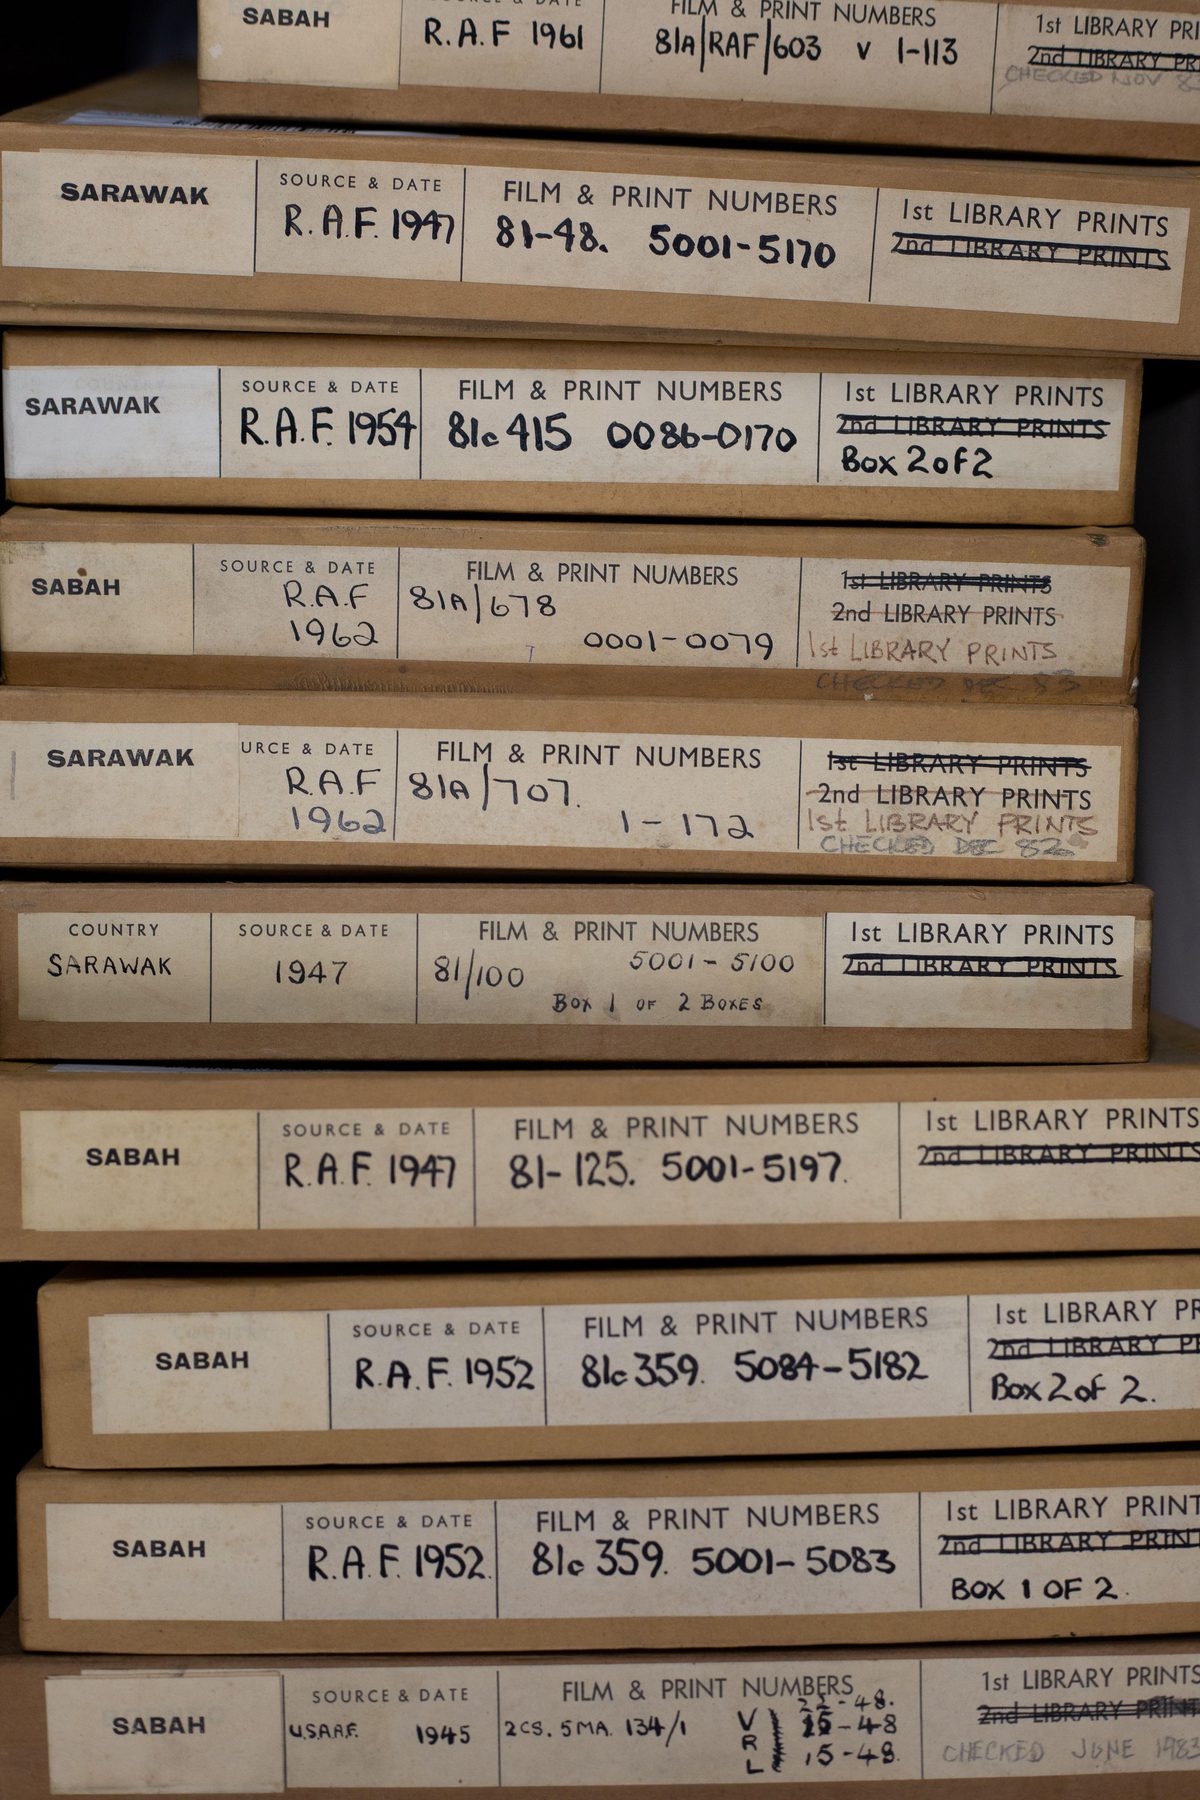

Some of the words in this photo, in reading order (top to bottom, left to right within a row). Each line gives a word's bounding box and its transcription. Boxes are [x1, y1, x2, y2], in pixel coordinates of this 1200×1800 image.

[243, 7, 329, 28] SABAH
[672, 0, 717, 20] FILM
[731, 0, 746, 18] &
[760, 0, 820, 22] PRINT
[834, 3, 936, 27] NUMBERS
[425, 17, 510, 48] R.A.F
[532, 21, 583, 50] 1961
[1037, 14, 1061, 34] 1st
[1074, 16, 1158, 38] LIBRARY
[898, 37, 958, 66] 1-113
[61, 183, 209, 205] SARAWAK
[280, 173, 356, 188] SOURCE
[369, 177, 378, 189] &
[393, 178, 441, 192] DATE
[504, 181, 560, 203] FILM
[577, 184, 594, 205] &
[613, 185, 692, 209] PRINT
[709, 190, 836, 216] NUMBERS
[285, 204, 378, 239] R.A.F.
[393, 209, 454, 244] 1947
[903, 199, 933, 221] 1st
[950, 202, 1061, 229] LIBRARY
[1077, 211, 1168, 237] PRINTS
[496, 215, 608, 253] 81-48.
[649, 224, 836, 269] 5001-5170
[243, 380, 316, 392] SOURCE
[328, 381, 337, 393] &
[352, 381, 398, 393] DATE
[460, 380, 513, 400] FILM
[530, 380, 546, 400] &
[565, 380, 641, 401] PRINT
[658, 381, 782, 401] NUMBERS
[847, 381, 875, 402] 1st
[892, 383, 999, 404] LIBRARY
[1016, 385, 1103, 407] PRINTS
[26, 396, 160, 416] SARAWAK
[241, 406, 333, 447] R.A.F.
[349, 408, 417, 450] 1954
[506, 412, 572, 452] 415
[607, 421, 797, 452] 0086-0170
[841, 445, 898, 476] Box
[220, 560, 293, 573] SOURCE
[305, 561, 315, 573] &
[329, 561, 374, 574] DATE
[468, 561, 515, 581] FILM
[528, 562, 544, 582] &
[558, 563, 620, 583] PRINT
[634, 564, 738, 586] NUMBERS
[32, 578, 120, 595] SABAH
[283, 580, 368, 609] R.A.F
[833, 600, 873, 622] 2nd
[884, 603, 973, 624] LIBRARY
[980, 606, 1056, 626] PRINTS
[290, 618, 378, 647] 1962
[584, 631, 773, 660] 0001-0079
[47, 749, 194, 768] SARAWAK
[242, 742, 289, 754] URCE
[302, 743, 311, 754] &
[326, 743, 373, 755] DATE
[438, 741, 492, 762] FILM
[509, 744, 525, 763] &
[543, 744, 620, 765] PRINT
[636, 746, 760, 769] NUMBERS
[286, 766, 381, 795] R.A.F
[819, 783, 861, 803] 2nd
[875, 784, 988, 807] LIBRARY
[999, 788, 1091, 810] PRINTS
[292, 807, 386, 834] 1962
[69, 924, 158, 936] COUNTRY
[239, 924, 312, 937] SOURCE
[322, 924, 331, 937] &
[342, 924, 387, 937] DATE
[480, 921, 527, 940] FILM
[543, 921, 558, 941] &
[575, 921, 637, 941] PRINT
[653, 922, 758, 942] NUMBERS
[853, 922, 881, 942] 1st
[898, 922, 1007, 944] LIBRARY
[1025, 924, 1113, 945] PRINTS
[47, 953, 171, 977] SARAWAK
[276, 960, 347, 985] 1947
[434, 949, 524, 1000] 81/100
[679, 993, 690, 1011] 2
[283, 1124, 361, 1137] SOURCE
[375, 1124, 384, 1135] &
[400, 1123, 448, 1135] DATE
[515, 1118, 572, 1140] FILM
[591, 1118, 607, 1139] &
[627, 1116, 708, 1138] PRINT
[727, 1112, 858, 1136] NUMBERS
[927, 1110, 957, 1131] 1st
[975, 1109, 1088, 1131] LIBRARY
[1107, 1107, 1199, 1129] PRINTS
[86, 1148, 179, 1166] SABAH
[285, 1151, 372, 1188] R.A.F.
[390, 1154, 456, 1189] 1947
[585, 1316, 642, 1338] FILM
[661, 1315, 677, 1336] &
[697, 1312, 777, 1335] PRINT
[796, 1306, 928, 1332] NUMBERS
[997, 1304, 1027, 1324] 1st
[1045, 1300, 1157, 1323] LIBRARY
[353, 1323, 431, 1338] SOURCE
[445, 1323, 454, 1335] &
[470, 1321, 519, 1335] DATE
[156, 1351, 248, 1370] SABAH
[356, 1357, 452, 1390] R.A.F.
[466, 1355, 535, 1390] 1952
[734, 1347, 929, 1383] 5084-5182
[991, 1372, 1042, 1401] Box
[1048, 1372, 1072, 1402] 2
[537, 1510, 594, 1532] FILM
[612, 1510, 629, 1531] &
[649, 1507, 729, 1530] PRINT
[748, 1503, 879, 1528] NUMBERS
[948, 1500, 978, 1521] 1st
[996, 1497, 1108, 1520] LIBRARY
[306, 1516, 384, 1529] SOURCE
[397, 1516, 407, 1528] &
[422, 1515, 472, 1527] DATE
[113, 1540, 205, 1557] SABAH
[308, 1544, 400, 1582] R.A.F.
[952, 1577, 1005, 1600] BOX
[1022, 1579, 1030, 1599] 1
[1043, 1577, 1082, 1600] OF
[563, 1681, 613, 1701] FILM
[629, 1680, 645, 1700] &
[662, 1678, 727, 1699] PRINT
[743, 1675, 853, 1698] NUMBERS
[983, 1672, 1009, 1691] 1st
[1024, 1668, 1113, 1689] LIBRARY
[313, 1690, 388, 1703] SOURCE
[399, 1689, 409, 1702] &
[420, 1688, 467, 1701] DATE
[113, 1716, 205, 1735] SABAH
[416, 1725, 470, 1745] 1945
